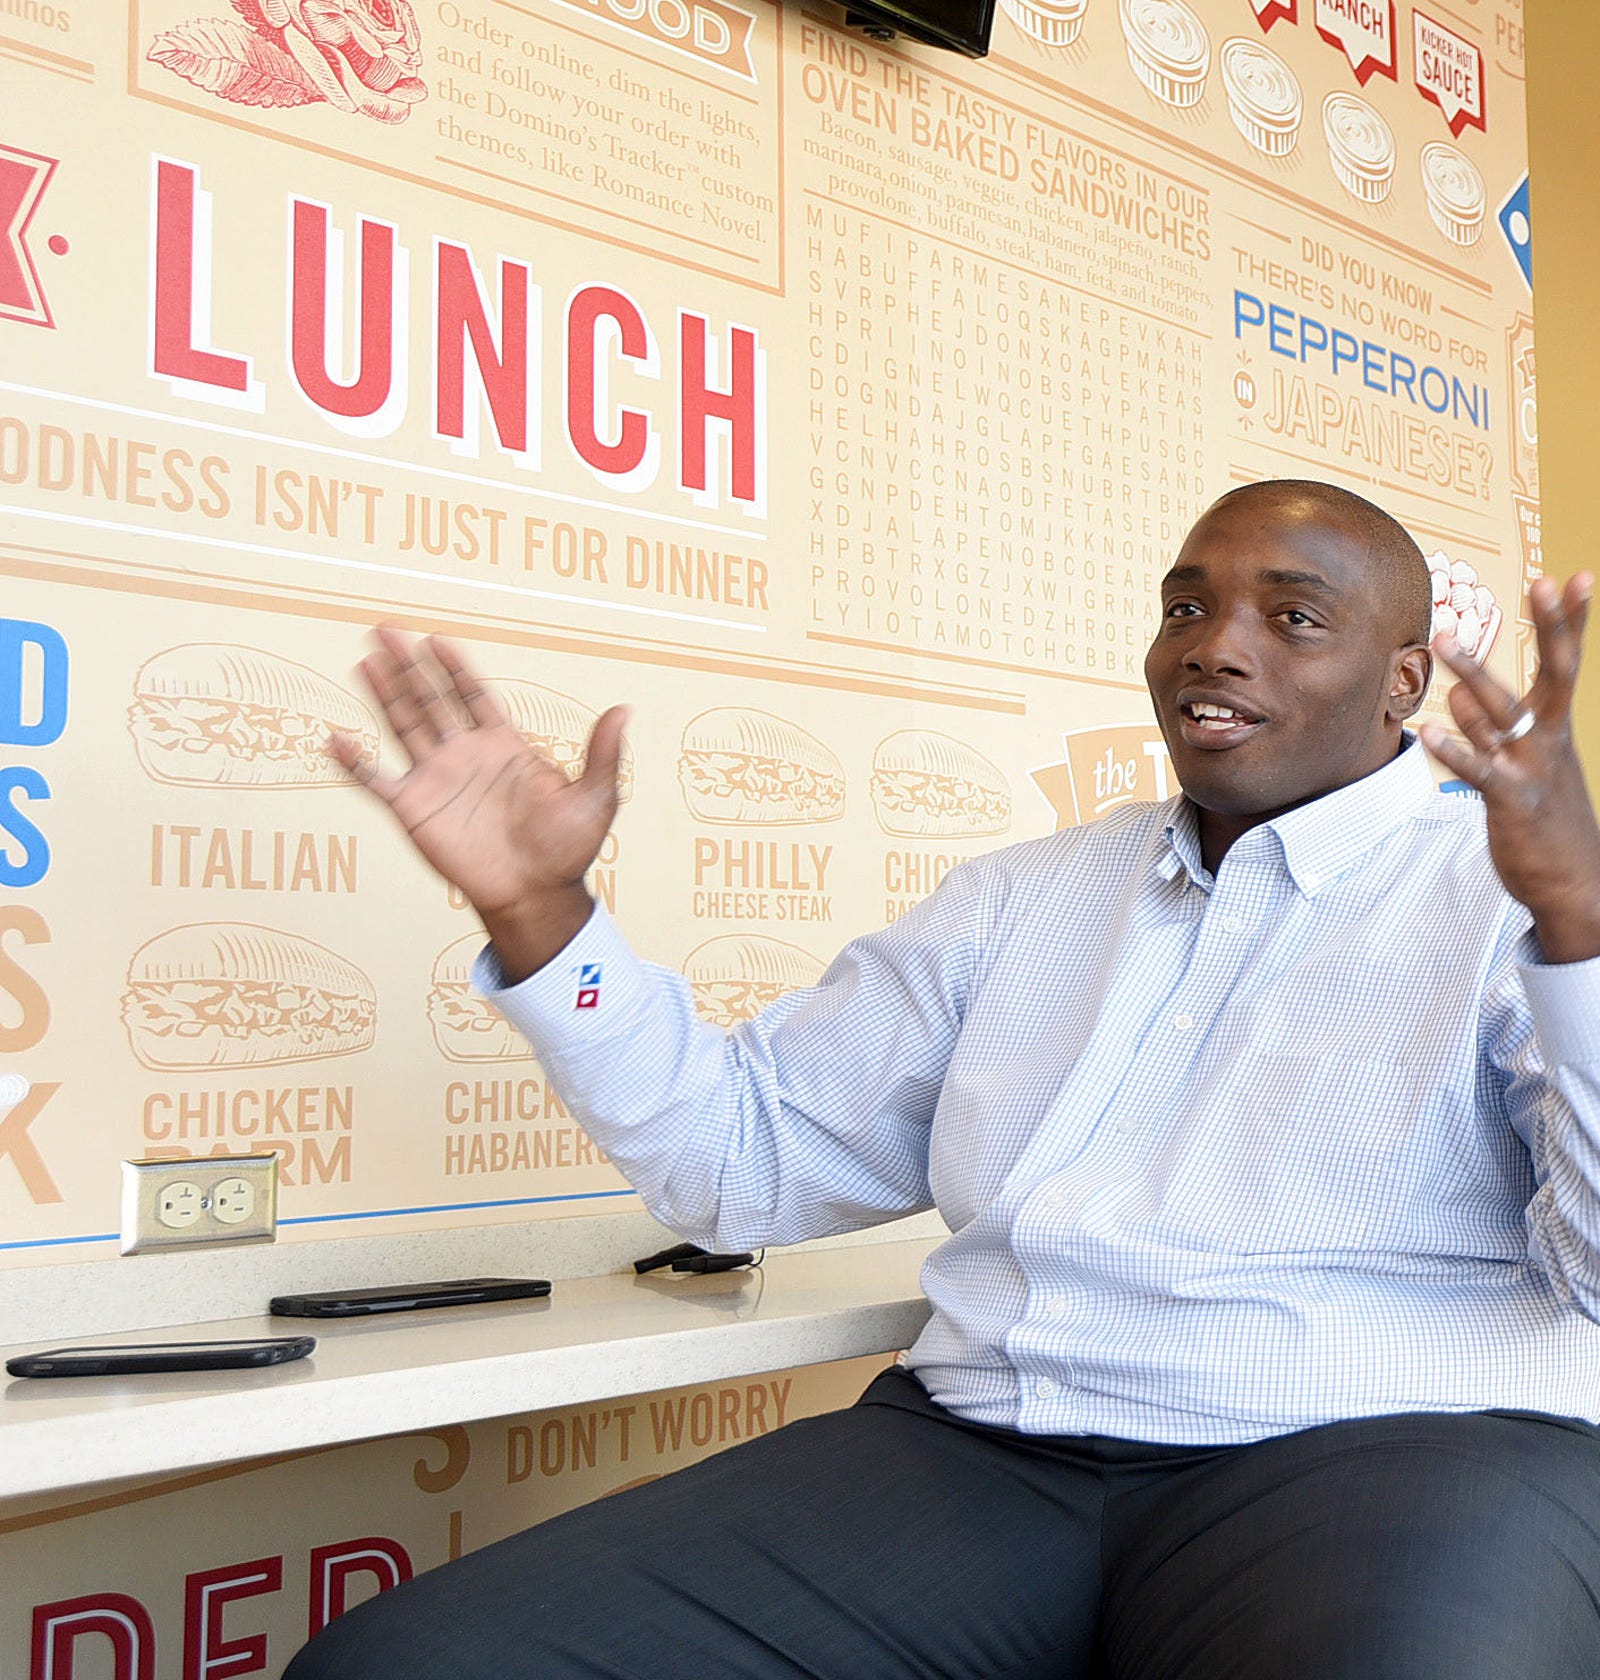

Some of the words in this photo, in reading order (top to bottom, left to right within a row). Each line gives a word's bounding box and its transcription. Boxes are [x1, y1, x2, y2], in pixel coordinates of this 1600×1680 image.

[437, 43, 483, 76] and
[491, 58, 567, 104] follow
[573, 94, 625, 126] your
[631, 112, 690, 150] order
[696, 138, 743, 171] with
[438, 0, 514, 49] Order
[521, 38, 601, 87] online,
[609, 68, 651, 102] dim
[658, 86, 693, 118] the
[700, 101, 761, 147] lights,
[1421, 49, 1475, 105] SAUCE
[1456, 44, 1473, 70] HOT
[436, 114, 535, 171] themes,
[542, 147, 585, 184] like
[591, 165, 694, 219] Romance
[702, 201, 767, 243] Novel.
[437, 78, 478, 110] the
[701, 172, 775, 214] custom
[801, 24, 868, 78] FIND
[878, 57, 932, 108] THE
[941, 85, 1016, 141] TASTY
[1026, 123, 1128, 190] FLAVORS
[1136, 170, 1158, 200] IN
[1166, 185, 1210, 226] OUR
[802, 62, 897, 136] OVEN
[911, 106, 1020, 182] BAKED
[1030, 157, 1211, 262] SANDWICHES
[819, 111, 883, 158] Bacon,
[888, 145, 958, 189] sausage,
[963, 174, 1020, 213] veggie,
[1024, 196, 1089, 239] chicken,
[828, 174, 922, 226] provolone,
[927, 204, 991, 250] buffalo,
[996, 237, 1041, 268] steak,
[1045, 253, 1083, 284] ham,
[1120, 283, 1147, 306] and
[1302, 235, 1334, 273] DID
[1338, 253, 1376, 291] YOU
[1381, 271, 1433, 316] KNOW
[150, 153, 770, 510] LUNCH
[1234, 288, 1490, 432] PEPPERONI
[1236, 379, 1254, 402] IN
[1341, 292, 1375, 327] NO
[1379, 308, 1443, 355] WORD
[1449, 336, 1488, 374] FOR
[1263, 367, 1494, 502] JAPANESE?
[254, 463, 384, 545] ISN’T
[399, 495, 509, 567] JUST
[523, 517, 609, 585] FOR
[626, 534, 770, 612] DINNER
[1093, 746, 1137, 800] the
[151, 824, 358, 895] ITALIAN
[692, 890, 770, 921] CHEESE
[775, 894, 833, 923] STEAK
[694, 837, 834, 893] PHILLY
[143, 1086, 354, 1143] CHICKEN
[649, 1378, 793, 1455] WORRY
